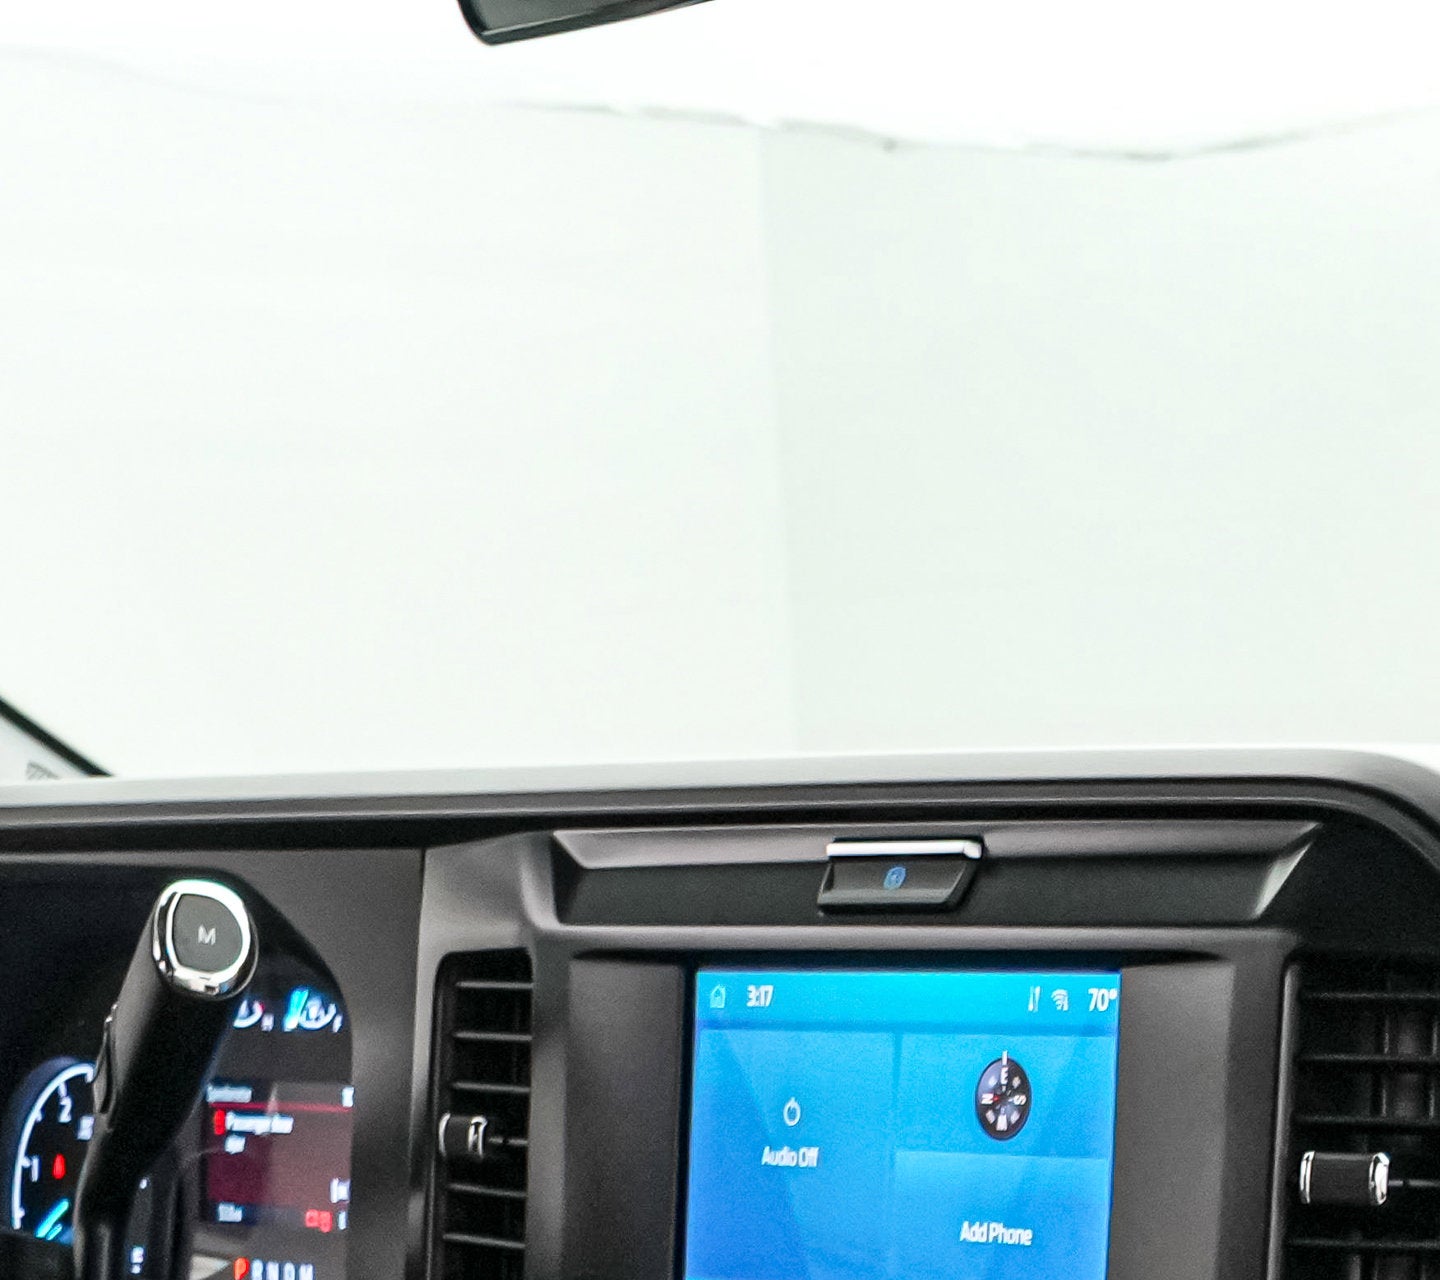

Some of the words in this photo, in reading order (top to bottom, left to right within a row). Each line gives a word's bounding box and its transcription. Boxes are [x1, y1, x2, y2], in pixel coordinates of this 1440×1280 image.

[198, 926, 216, 944] M
[60, 1102, 73, 1123] 2
[761, 1146, 797, 1167] Audio
[798, 1147, 820, 1168] Off
[959, 1220, 987, 1243] Add
[988, 1222, 1033, 1247] Phone
